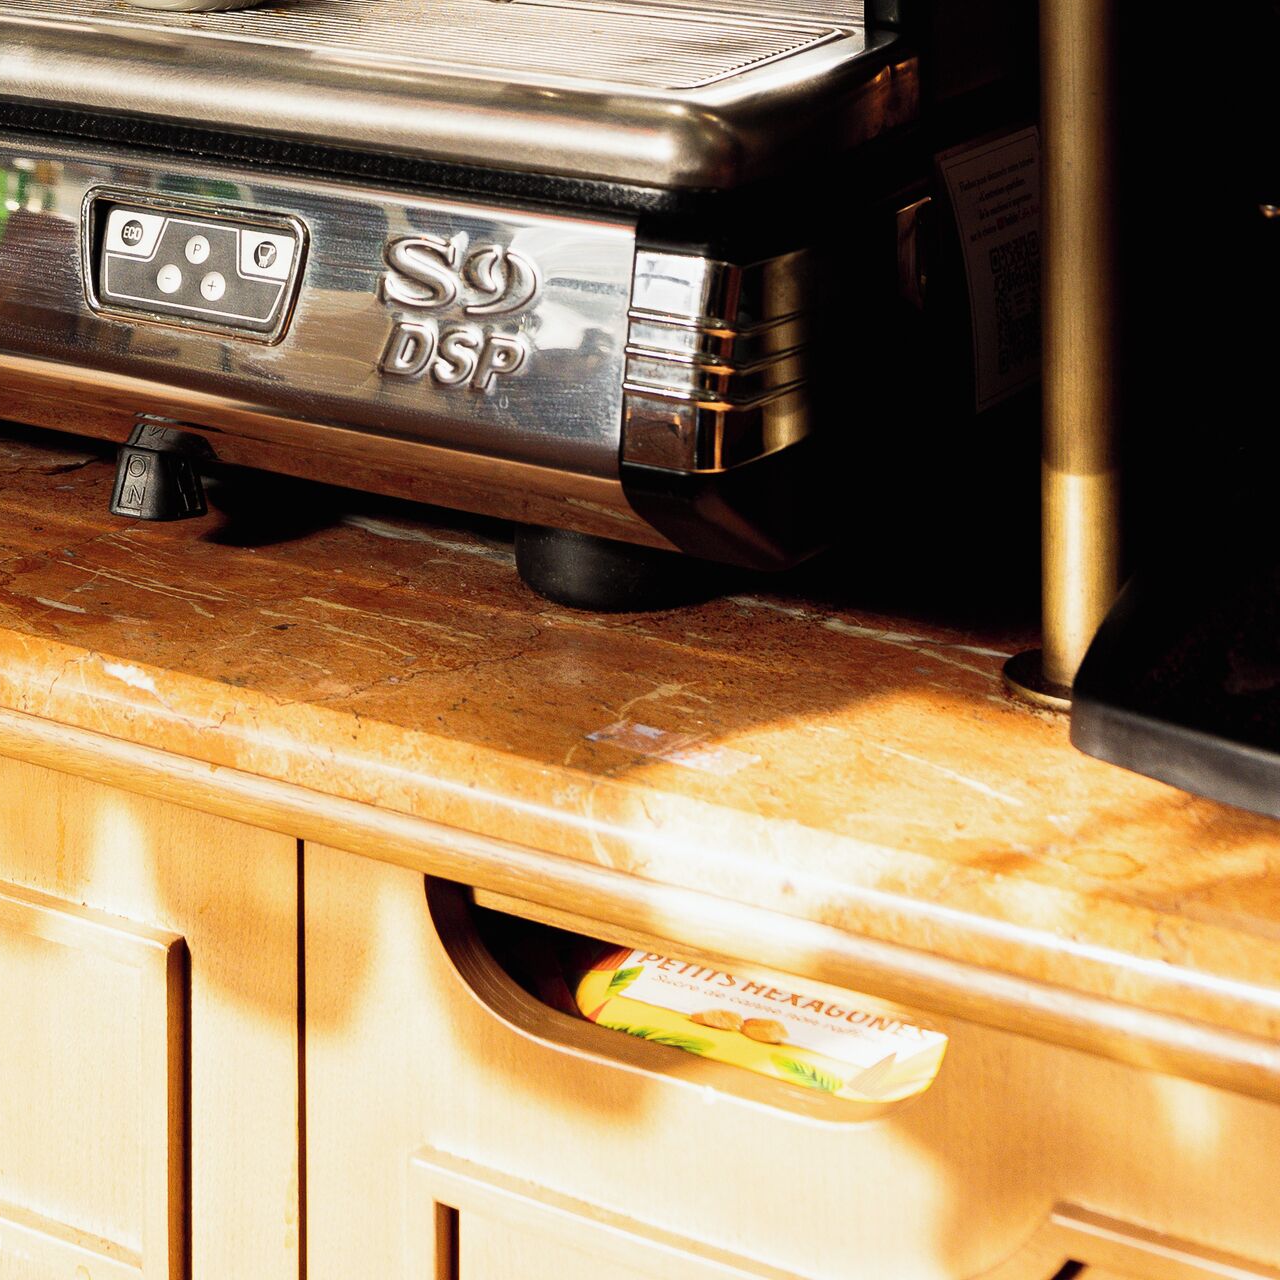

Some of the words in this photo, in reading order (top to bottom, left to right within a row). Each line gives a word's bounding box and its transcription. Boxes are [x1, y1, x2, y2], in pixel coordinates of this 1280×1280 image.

[123, 226, 141, 241] ECO
[192, 243, 202, 255] P
[378, 235, 538, 316] S9
[378, 320, 528, 393] DSP
[638, 952, 737, 987] PETITS
